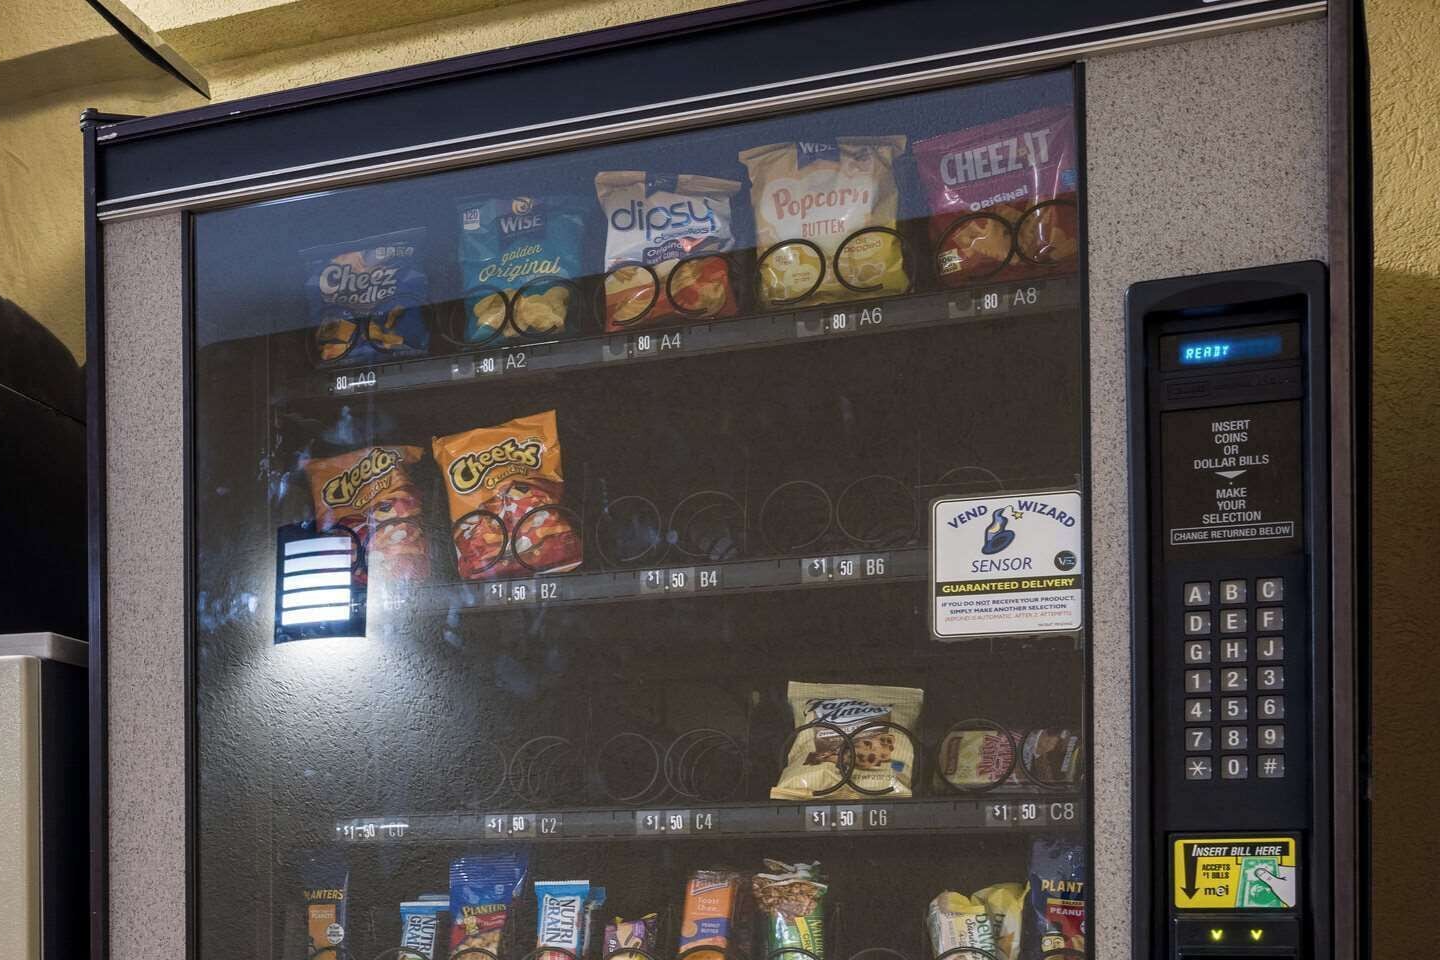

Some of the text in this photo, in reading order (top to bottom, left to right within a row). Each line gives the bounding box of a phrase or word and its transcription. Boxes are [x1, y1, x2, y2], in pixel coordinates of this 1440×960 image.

[772, 187, 868, 220] Popcorn
[500, 214, 544, 234] WISE
[611, 197, 716, 241] dipsy
[502, 244, 543, 265] golden
[479, 257, 561, 282] Original
[320, 264, 399, 295] Cheez
[1013, 288, 1037, 306] A8
[860, 308, 882, 326] A6
[661, 332, 681, 349] A4
[506, 352, 527, 369] A2
[1186, 345, 1230, 360] READY
[1211, 419, 1250, 432] INSERT
[1214, 432, 1248, 445] COINS
[1223, 445, 1239, 456] OR
[451, 439, 541, 493] Cheetos
[1194, 454, 1269, 470] DOLLAR BILLS
[1216, 487, 1247, 499] MAKE
[1217, 499, 1246, 511] YOUR
[947, 500, 1076, 529] VEND WIZARD
[1202, 511, 1261, 524] SELECTION
[1174, 525, 1290, 542] CHANGE RETURNED BELOW
[814, 559, 884, 578] $1.50 B6
[971, 557, 1033, 573] SENSOR
[648, 571, 717, 589] $1.50 B4
[942, 578, 1075, 593] GUARANTEED DELIVERY
[491, 583, 557, 601] $1.50 B2
[1189, 582, 1275, 602] A B C
[1190, 612, 1274, 631] D E F
[1190, 640, 1274, 660] G H J
[1192, 670, 1275, 688] 1 2 3
[1191, 699, 1275, 717] 4 5 6
[1192, 729, 1276, 746] 7 8 9
[1228, 759, 1239, 775] 0
[814, 809, 887, 827] $1.50 C6
[994, 803, 1074, 820] $1.50 C8
[541, 818, 556, 833] C2
[646, 813, 712, 830] $1.50 C4
[1192, 844, 1282, 857] INSERT BILL HERE
[1204, 885, 1229, 896] mei
[546, 897, 560, 944] GRAIN
[560, 899, 575, 944] NUTRI
